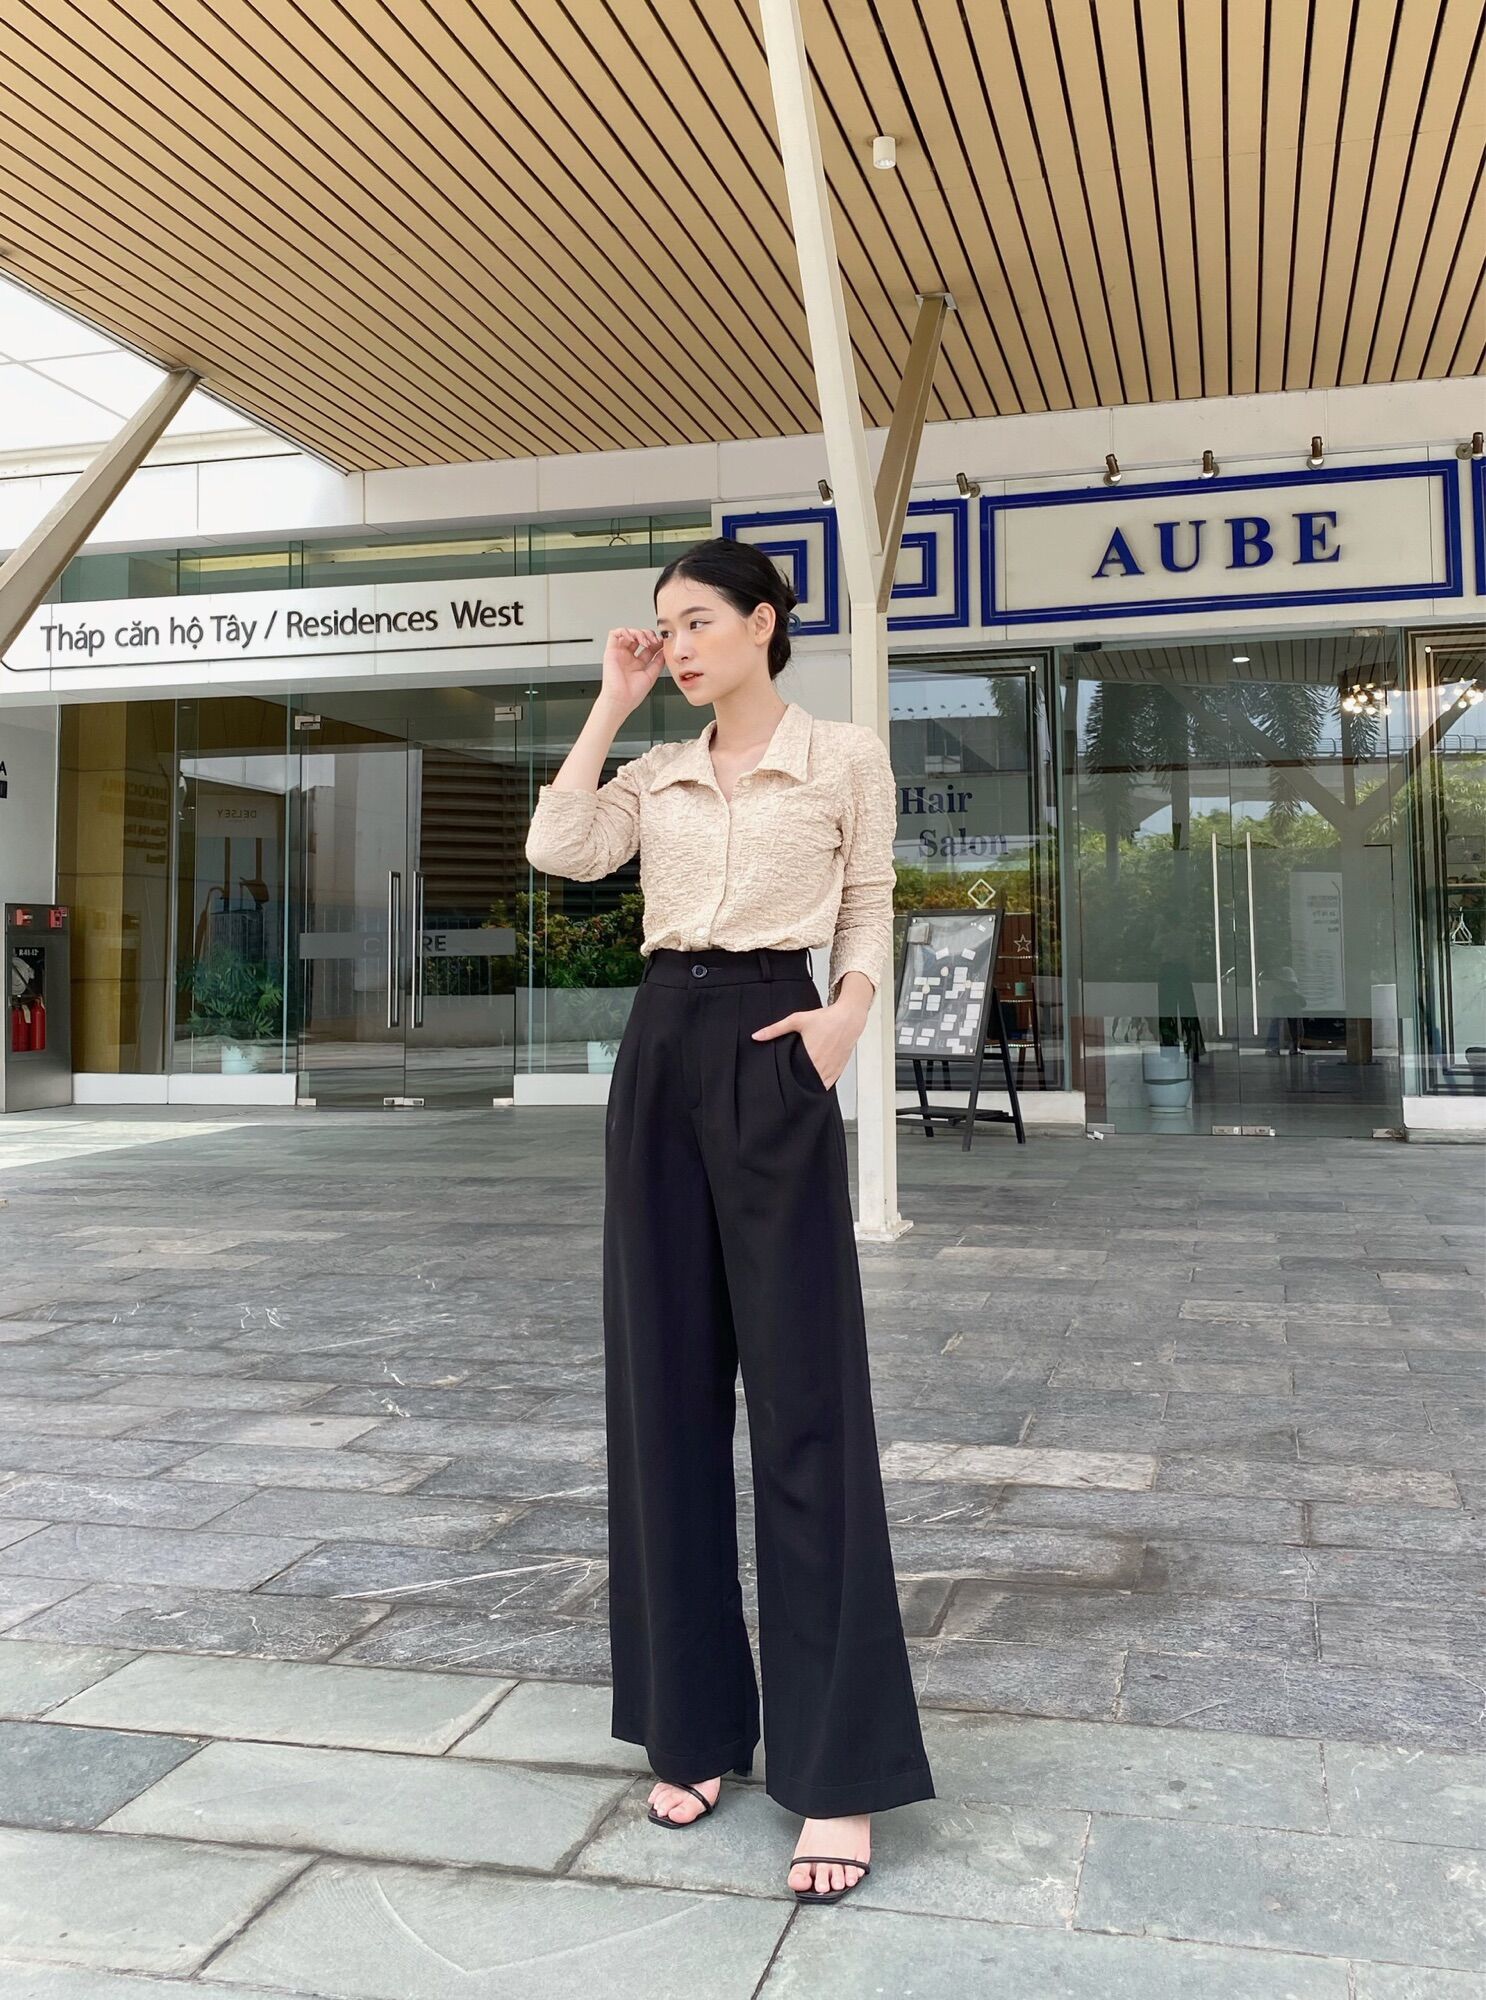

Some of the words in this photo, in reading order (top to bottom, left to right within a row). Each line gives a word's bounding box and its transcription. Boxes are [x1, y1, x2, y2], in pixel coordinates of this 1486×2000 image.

[1091, 510, 1341, 579] AUBE
[40, 622, 104, 657] Tháp
[115, 620, 160, 647] căn
[169, 617, 203, 650] hộ
[210, 613, 256, 650] Tây
[264, 610, 277, 640] /
[286, 605, 438, 638] Residences
[450, 599, 524, 629] West
[900, 785, 973, 815] Hair
[919, 827, 1008, 858] Salon
